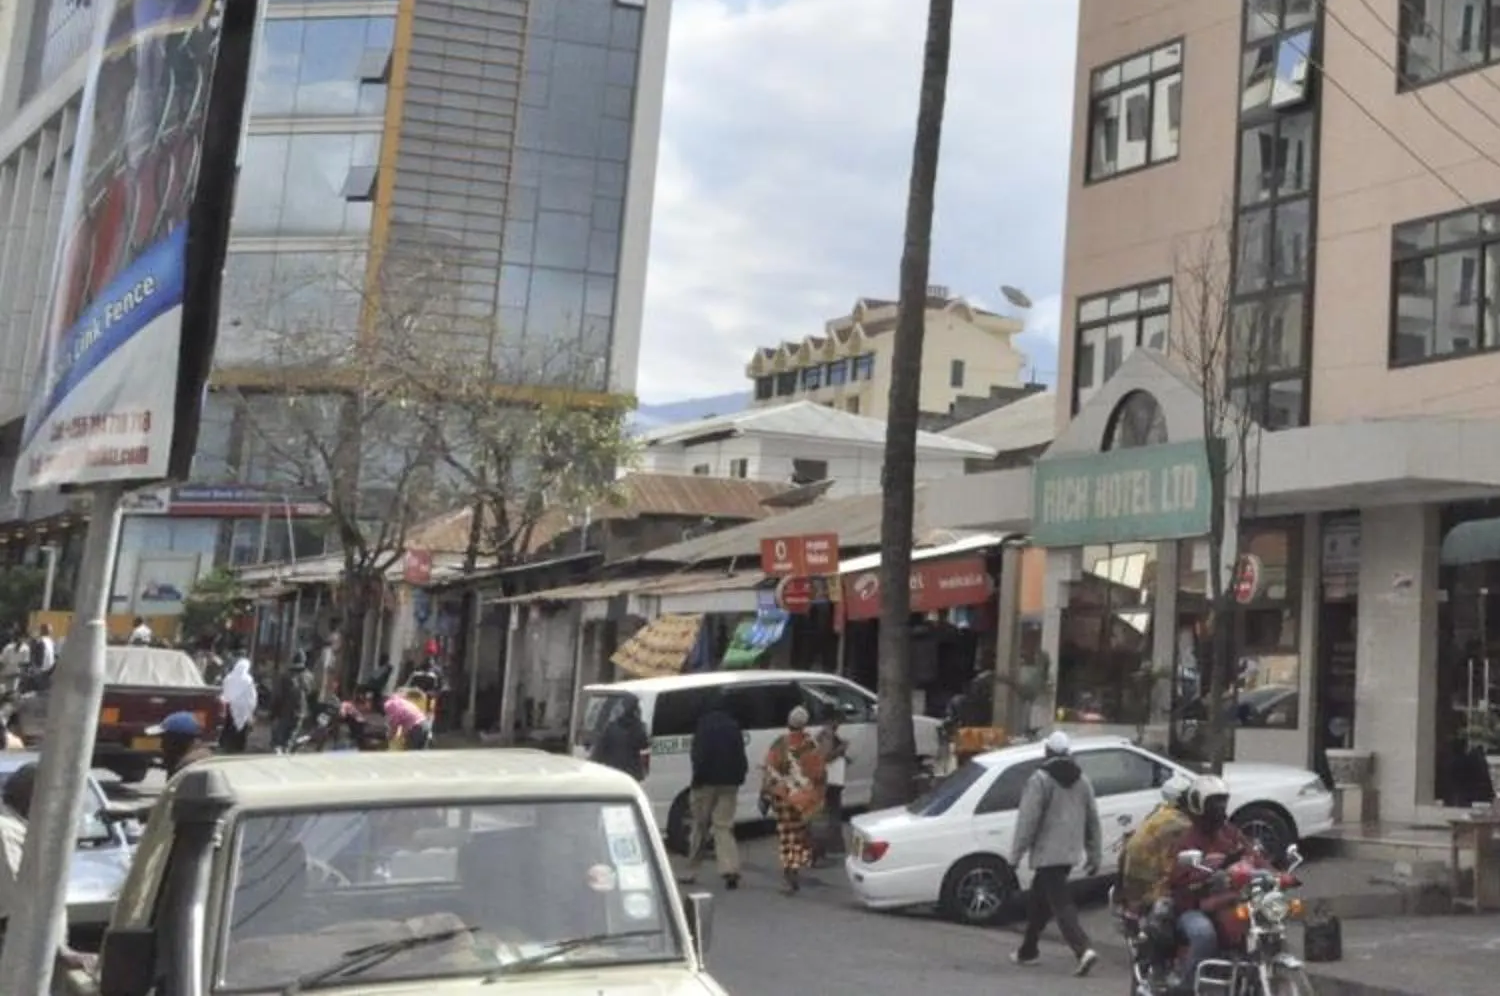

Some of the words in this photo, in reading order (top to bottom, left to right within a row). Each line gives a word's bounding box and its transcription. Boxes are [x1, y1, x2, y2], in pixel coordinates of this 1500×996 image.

[103, 275, 156, 329] Fence
[1043, 475, 1089, 524] RICH
[1094, 468, 1154, 519] HOTEL
[1160, 463, 1198, 513] LTD
